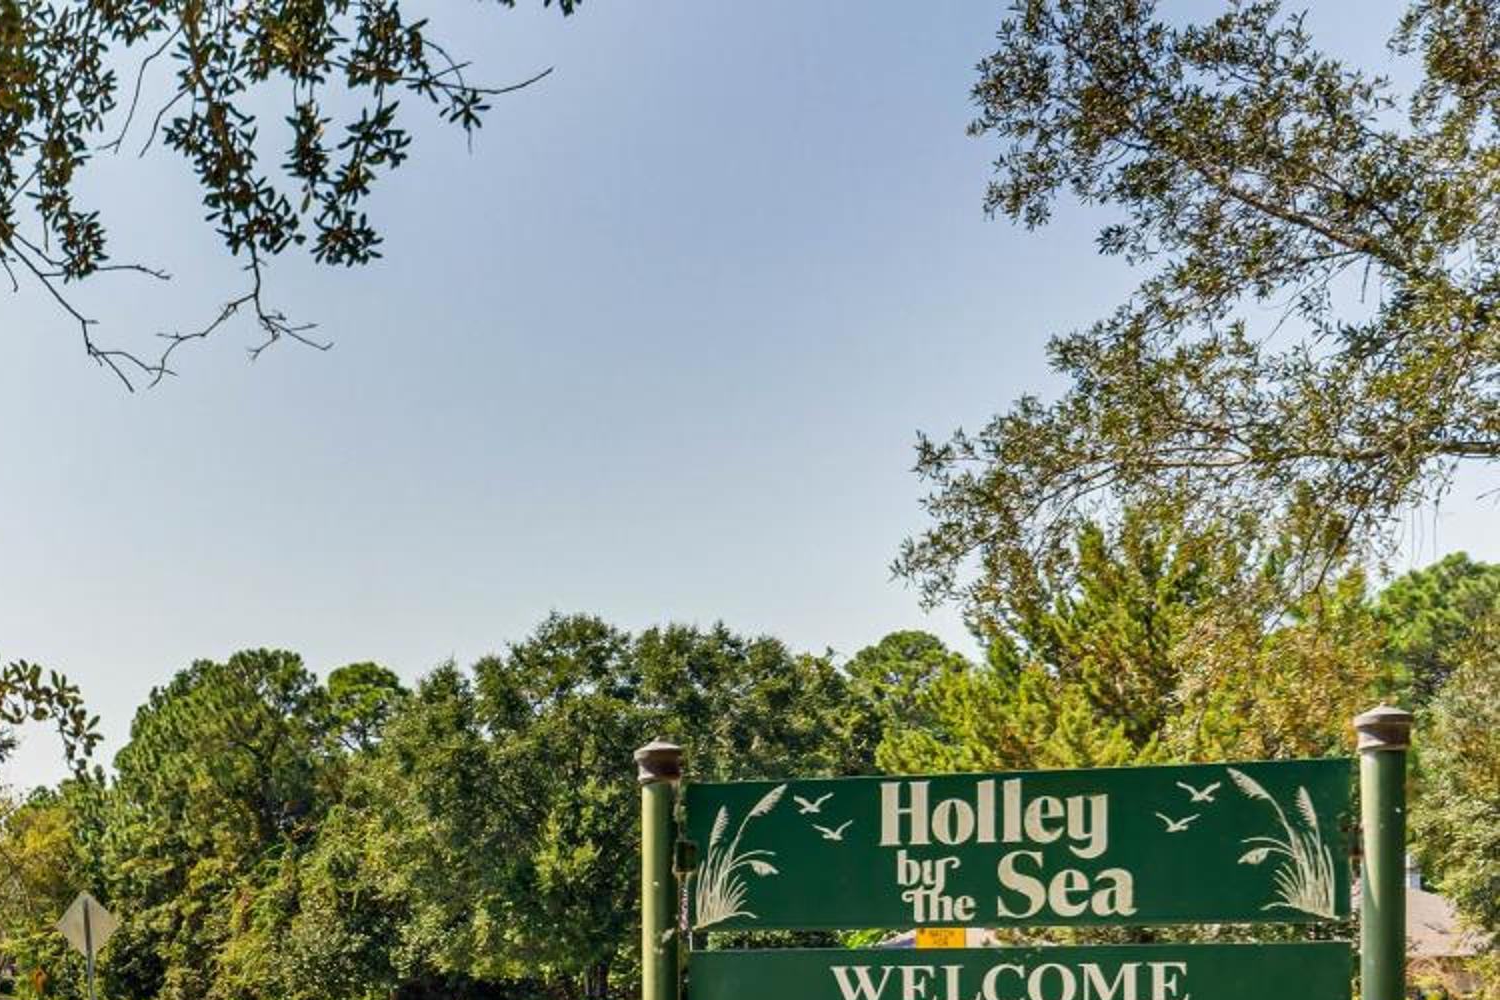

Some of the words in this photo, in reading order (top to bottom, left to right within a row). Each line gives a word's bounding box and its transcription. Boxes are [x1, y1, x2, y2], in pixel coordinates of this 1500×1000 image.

[879, 777, 1109, 859] Holley
[897, 849, 961, 895] by
[997, 850, 1139, 919] Sea
